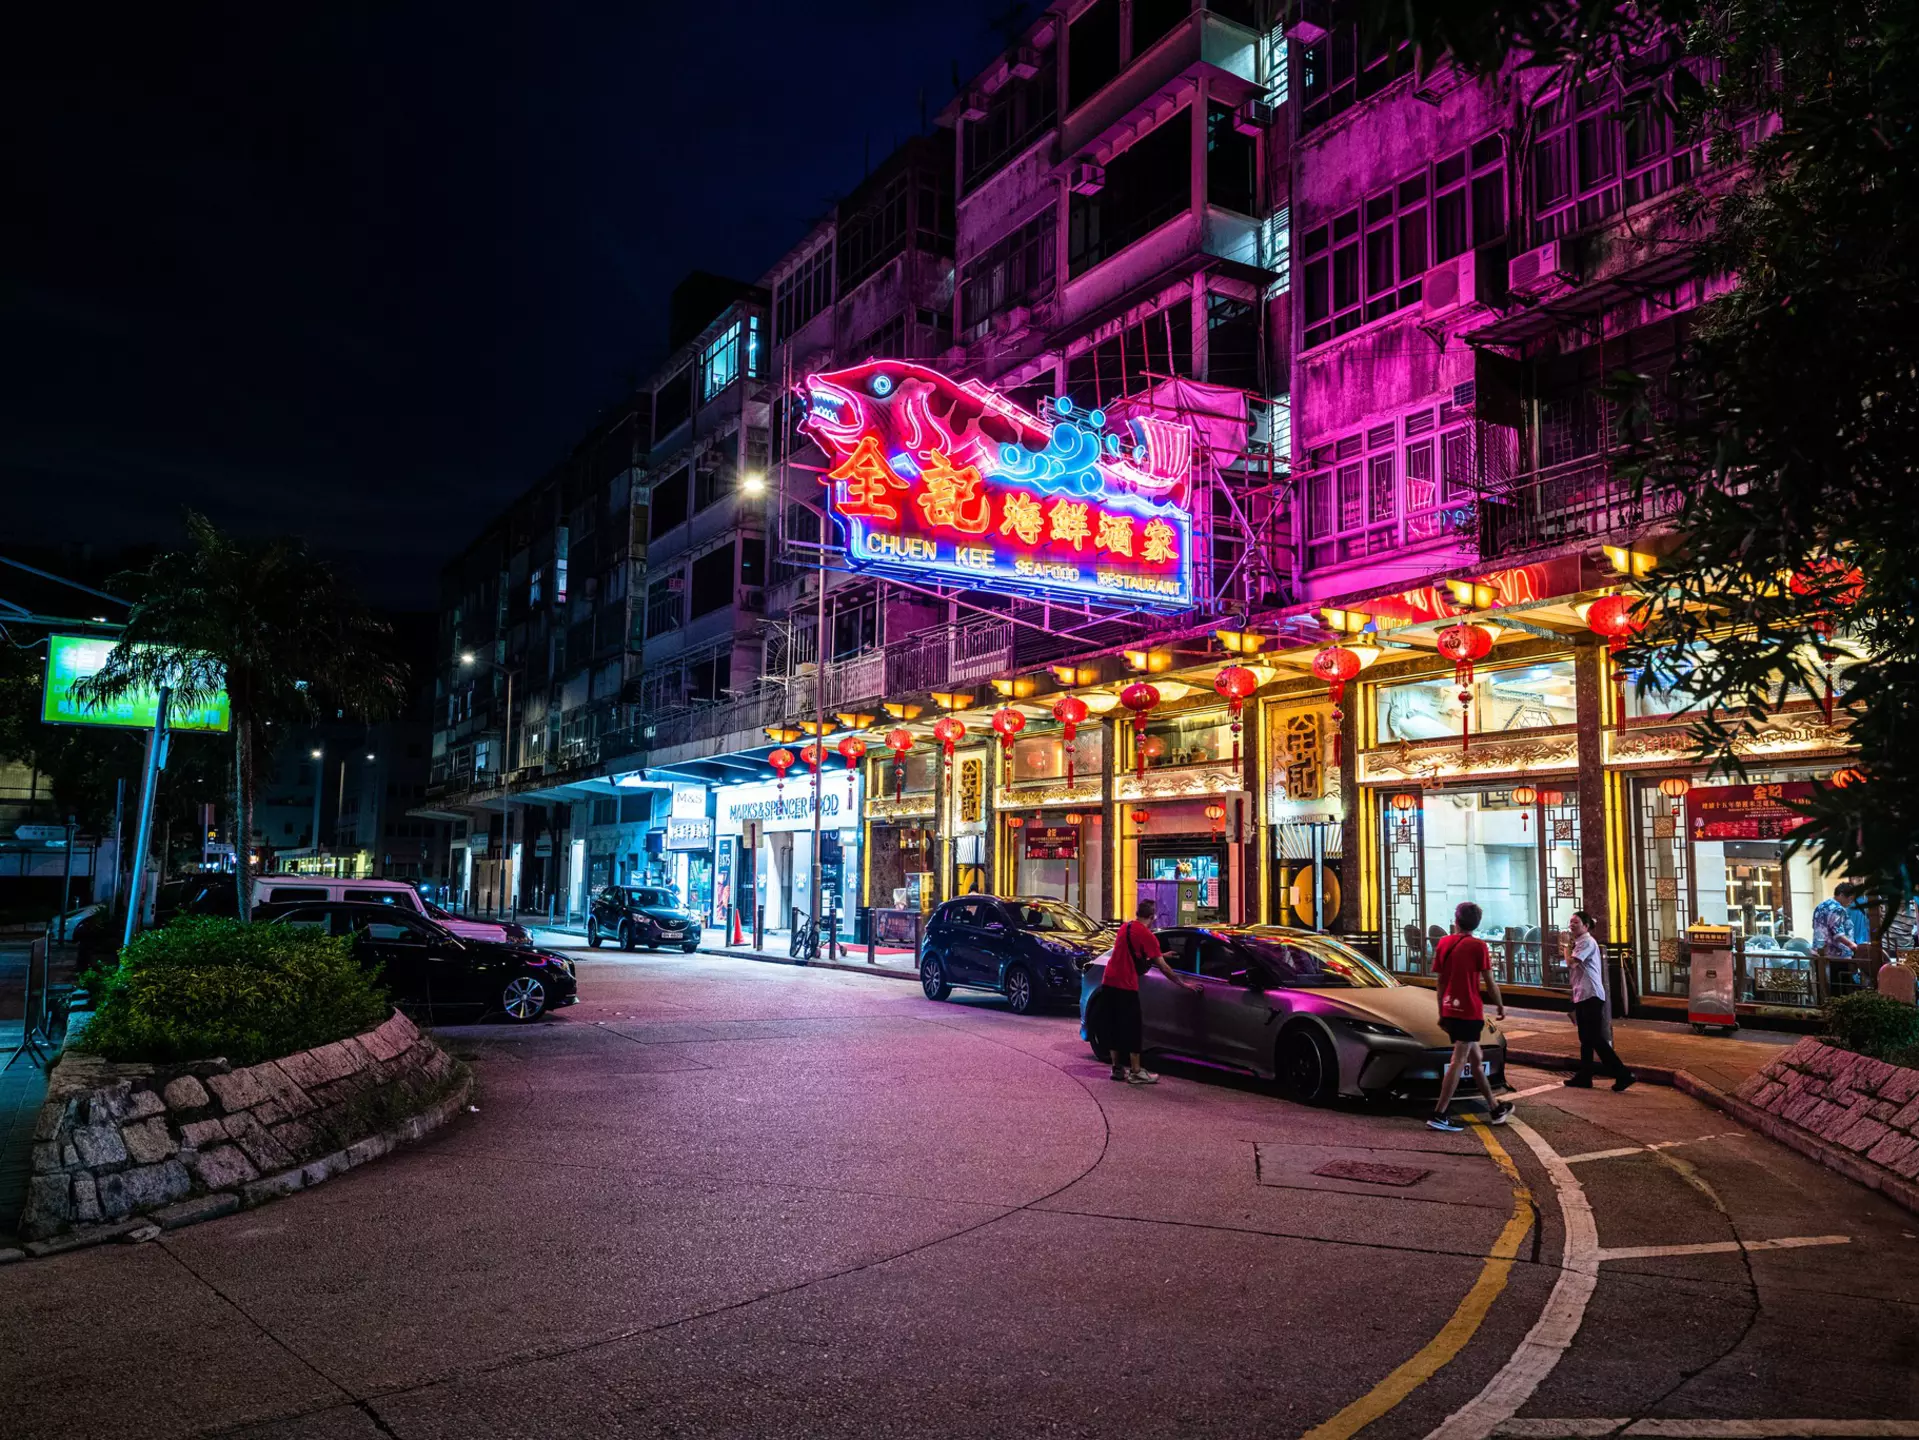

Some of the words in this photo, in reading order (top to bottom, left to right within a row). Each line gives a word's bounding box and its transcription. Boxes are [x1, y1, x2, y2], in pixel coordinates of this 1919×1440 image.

[866, 532, 937, 561] CHUEN
[955, 545, 996, 569] KEE
[1014, 559, 1080, 583] SEAFOOD
[1096, 571, 1182, 596] RESTAURANT
[676, 792, 703, 804] M&S
